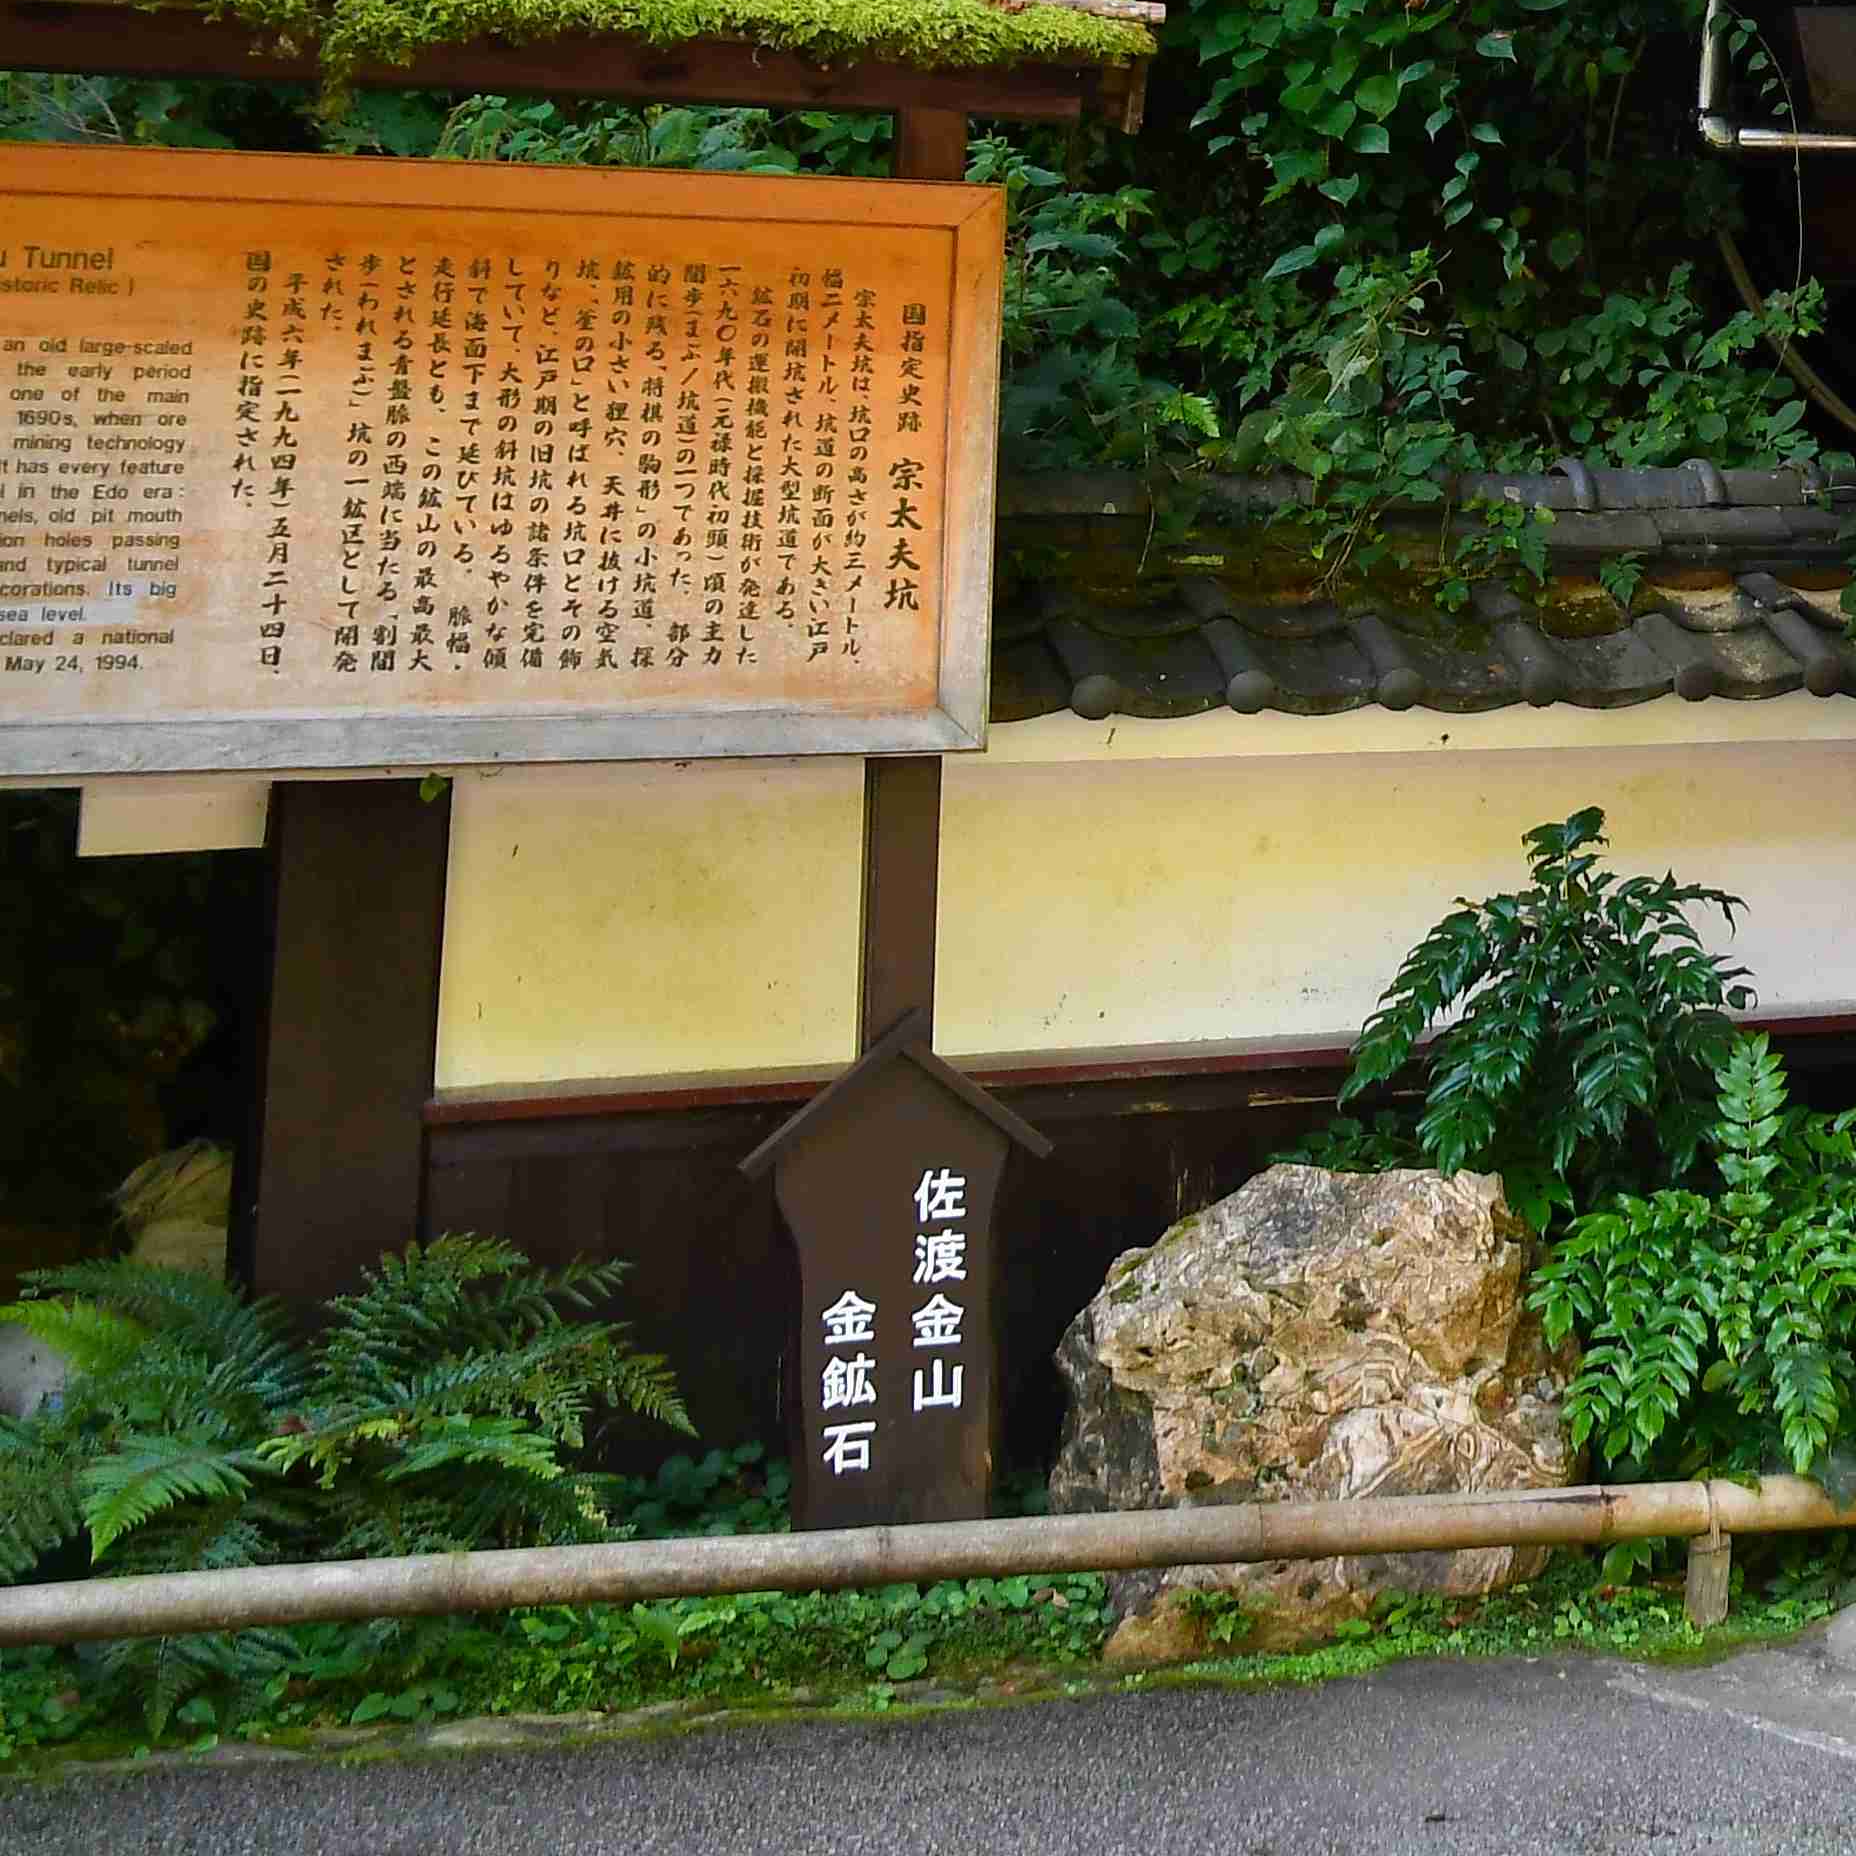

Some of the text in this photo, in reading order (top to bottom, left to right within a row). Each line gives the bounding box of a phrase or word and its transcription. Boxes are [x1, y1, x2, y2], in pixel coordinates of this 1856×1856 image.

[24, 246, 113, 270] Tunnel
[38, 338, 68, 353] old
[79, 338, 193, 357] large-scaled
[16, 362, 192, 381] the early period
[9, 387, 190, 404] one of the main
[17, 410, 187, 428] 1690s, when ore
[13, 434, 186, 453] mining technology
[884, 303, 927, 611] 国指定史跡 宗太夫坑
[16, 459, 49, 474] has
[58, 461, 111, 478] every
[119, 459, 185, 475] feature
[18, 483, 36, 499] in
[51, 484, 80, 500] the
[92, 484, 129, 500] Edo
[48, 508, 76, 524] old
[91, 508, 115, 524] pit
[127, 509, 183, 524] mouth
[44, 532, 93, 548] holes
[111, 533, 181, 550] passing
[47, 556, 107, 575] typical
[127, 556, 179, 573] tunnel
[108, 581, 133, 597] Its
[149, 580, 177, 600] big
[41, 606, 88, 622] level.
[72, 632, 84, 645] a
[101, 629, 175, 645] national
[5, 653, 144, 675] May 24, 1994.
[912, 1168, 967, 1412] 佐渡金山
[820, 1290, 877, 1476] 金鉱石
